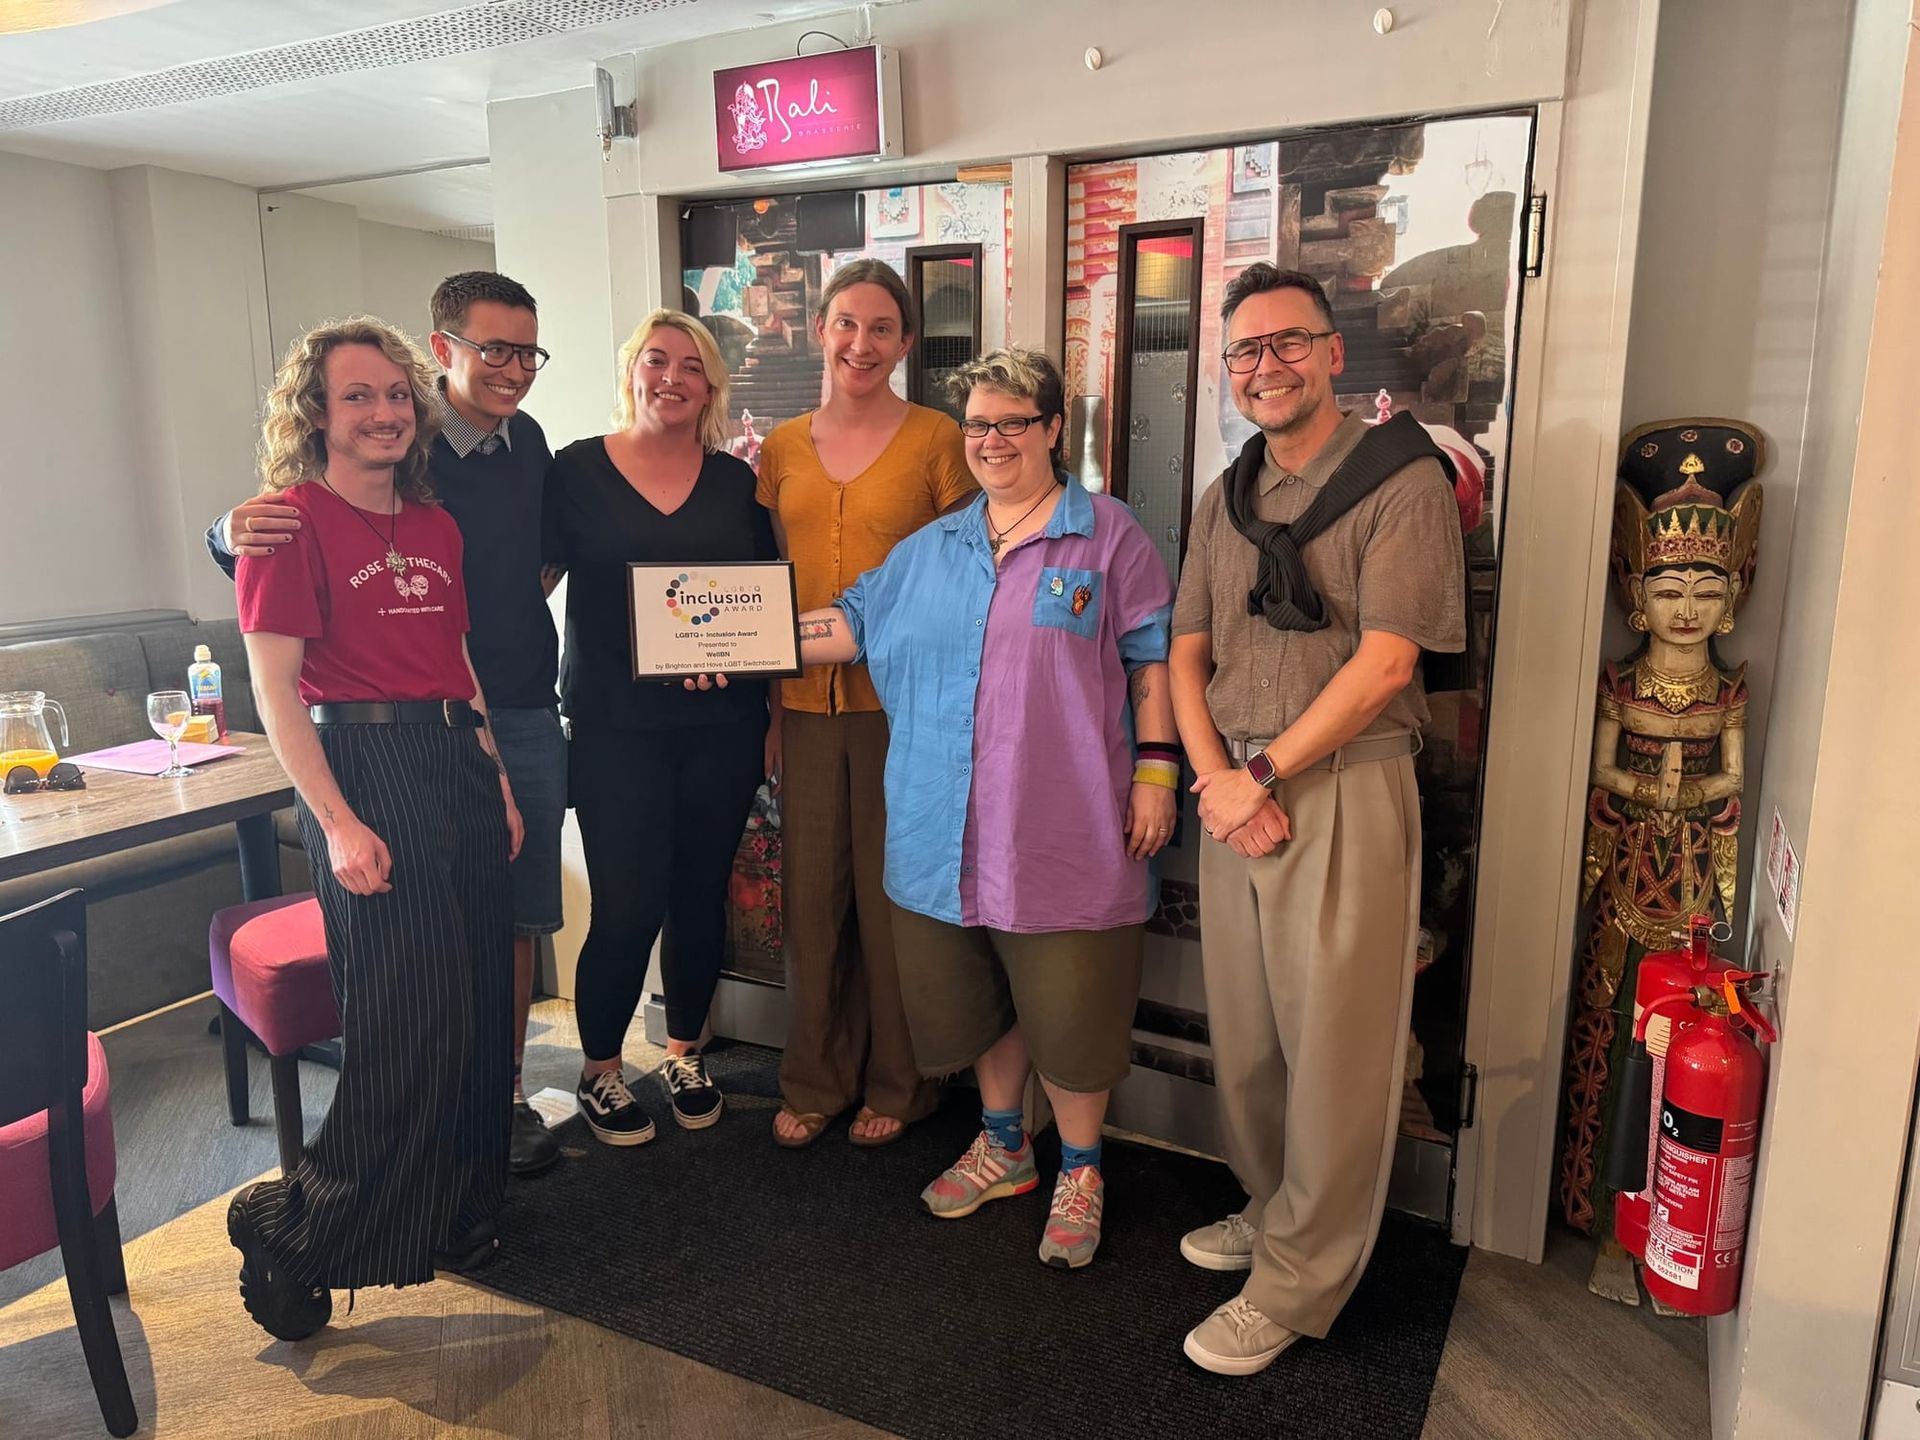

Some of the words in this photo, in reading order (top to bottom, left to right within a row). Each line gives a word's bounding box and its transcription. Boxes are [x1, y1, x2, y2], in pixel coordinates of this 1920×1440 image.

[757, 79, 837, 143] Bali
[798, 123, 861, 136] BRASSERIE
[349, 560, 384, 588] ROSE
[388, 556, 452, 587] THECARY
[680, 591, 762, 604] inclusion
[664, 662, 692, 670] Brighton
[742, 659, 781, 667] Switchboard
[1661, 1108, 1679, 1137] O2
[1649, 1246, 1694, 1275] PROTECTION
[1650, 1234, 1674, 1260] E&E
